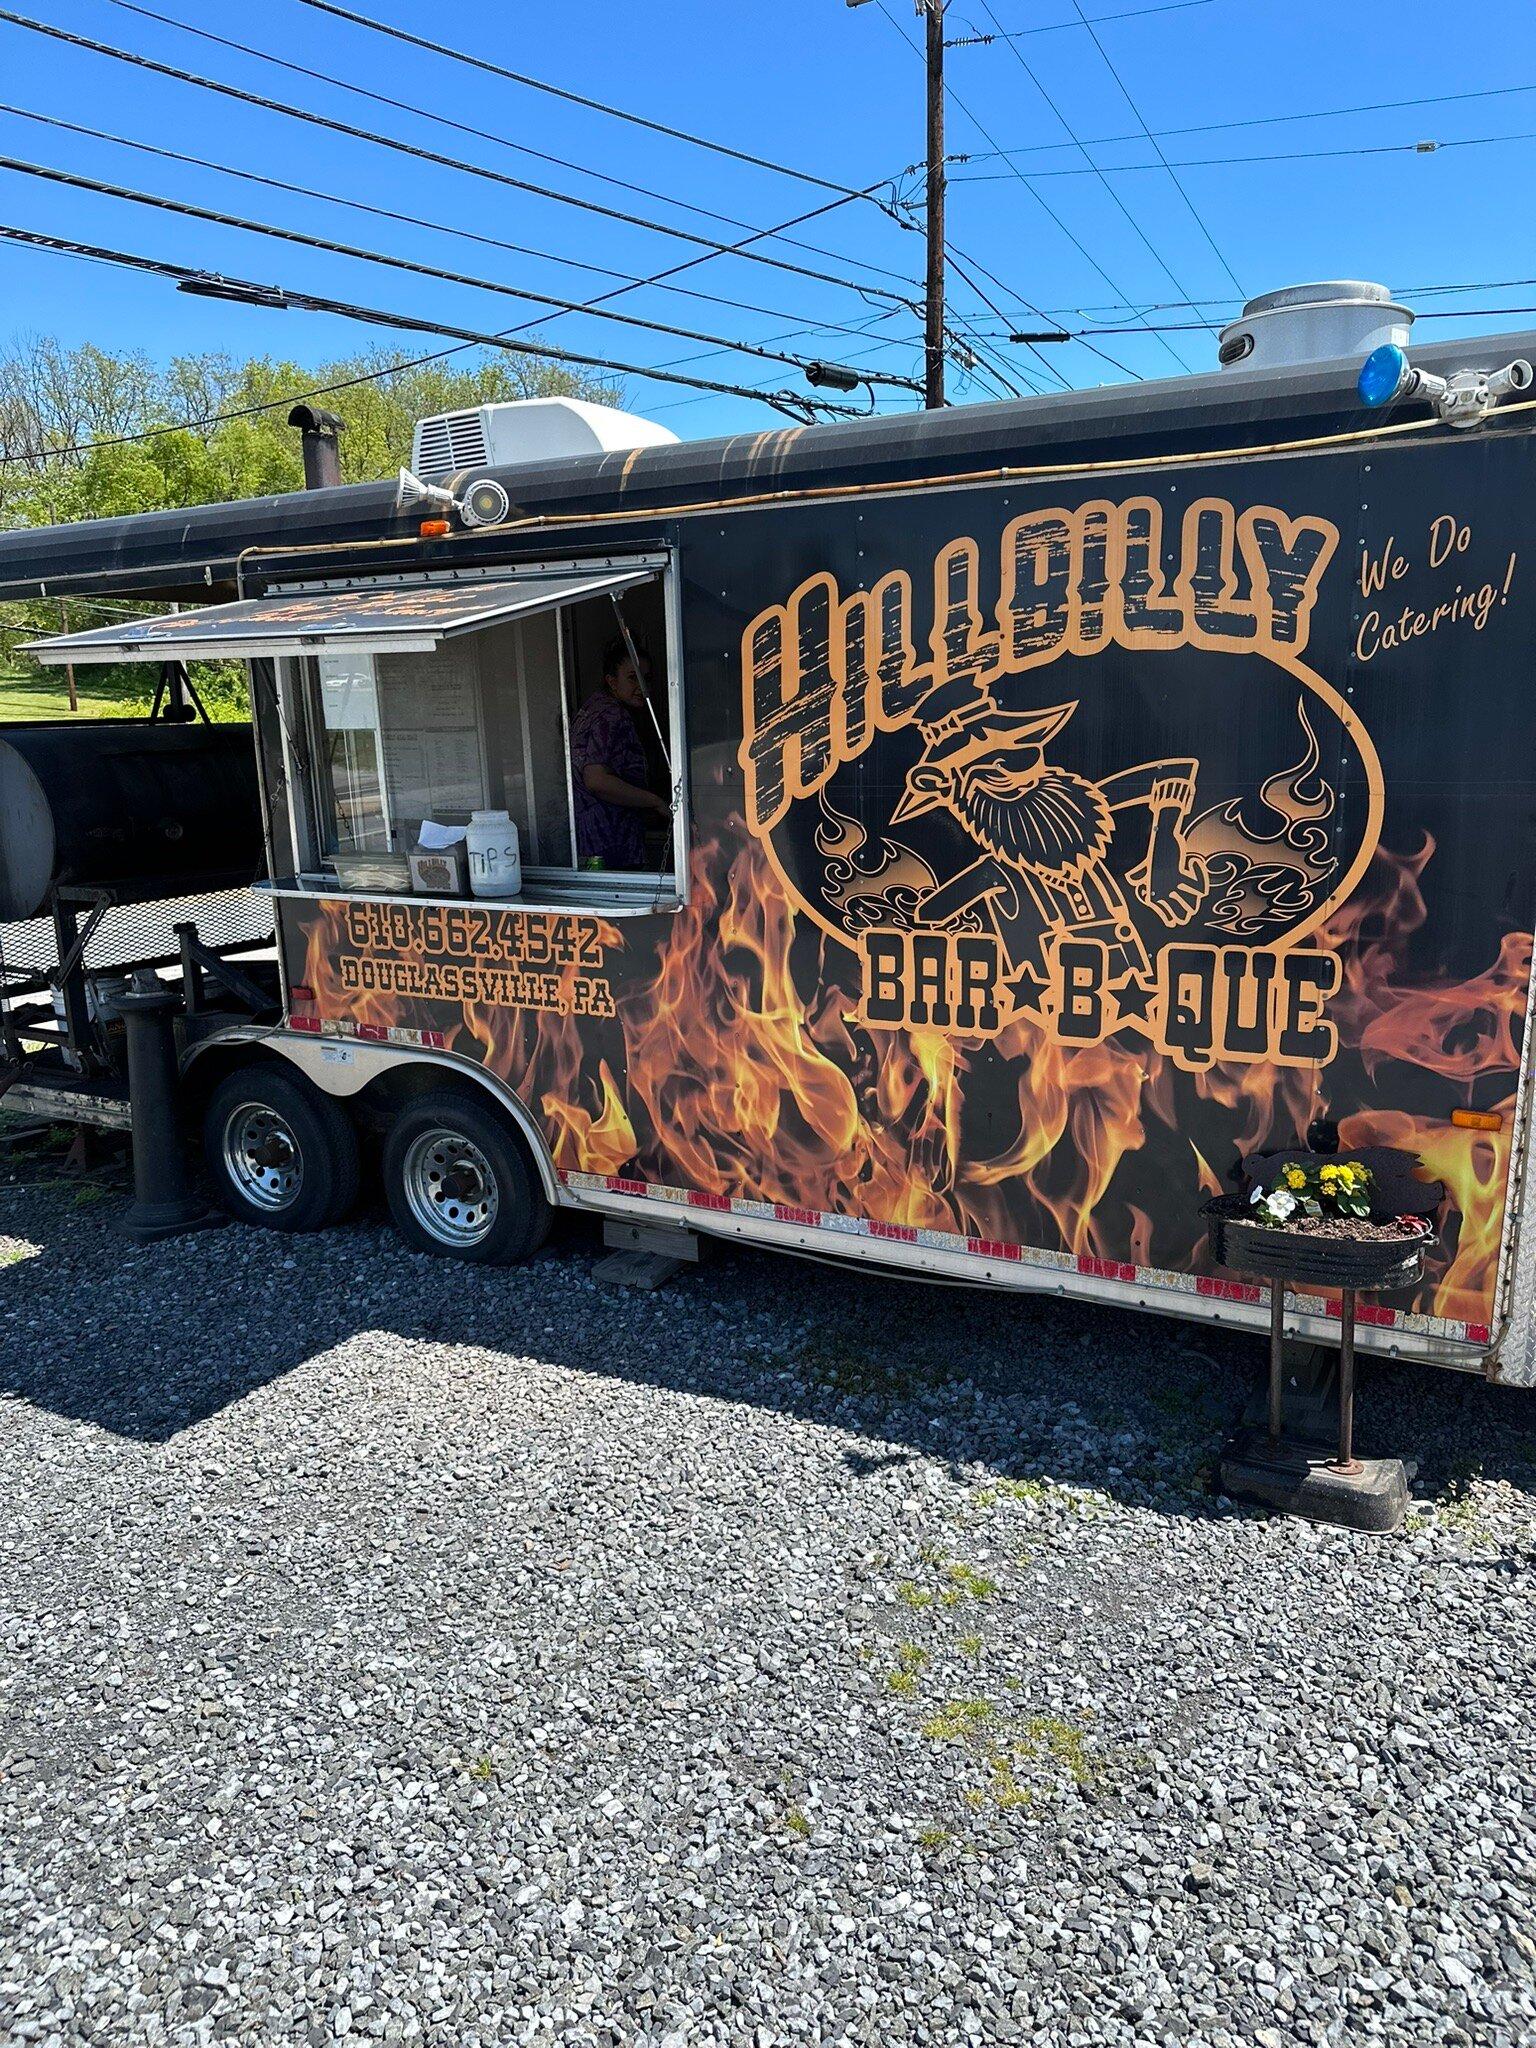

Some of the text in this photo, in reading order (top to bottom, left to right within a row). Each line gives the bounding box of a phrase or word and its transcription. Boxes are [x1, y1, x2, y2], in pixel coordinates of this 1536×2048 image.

[1361, 515, 1471, 598] We Do
[1356, 552, 1516, 661] Catering!
[738, 496, 1340, 837] HILLBILLY
[348, 902, 604, 968] 610.662.4542
[340, 956, 616, 1018] DOUGLASSVILLE, PA
[857, 927, 1343, 1072] BAR B QUE
